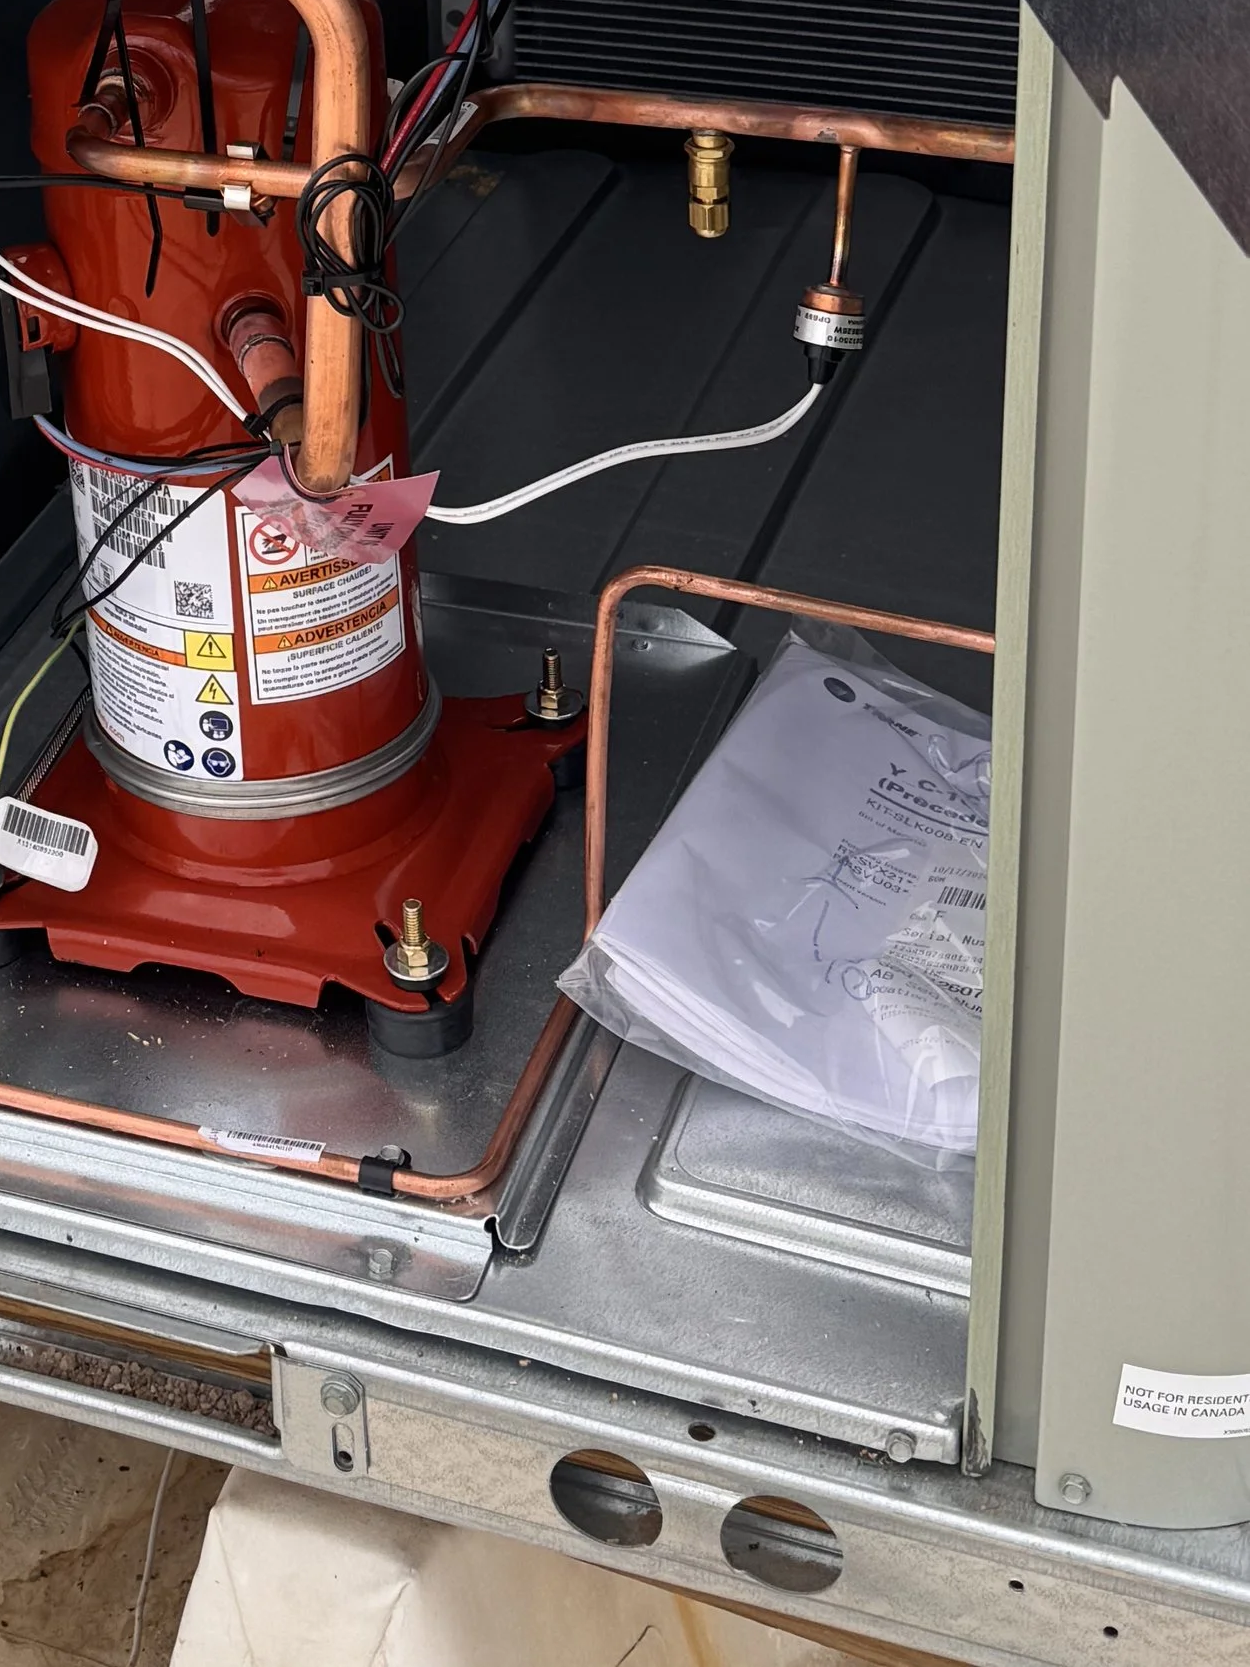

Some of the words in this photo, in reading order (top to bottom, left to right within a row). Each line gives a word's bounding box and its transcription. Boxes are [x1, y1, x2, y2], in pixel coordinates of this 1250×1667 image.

[280, 558, 358, 587] AVERTISS
[293, 583, 336, 599] SURFACE
[337, 565, 372, 587] CHAUDE!
[294, 601, 387, 646] ADVERTENCIA
[287, 640, 344, 662] ¡SUPERFICIE
[345, 620, 384, 645] CALIENTE!
[1123, 1397, 1170, 1414] USAGE
[1174, 1406, 1188, 1416] IN
[1191, 1407, 1245, 1417] CANADA
[1125, 1385, 1154, 1399] NOT
[1158, 1392, 1184, 1404] FOR
[1188, 1394, 1250, 1405] RESIDENT
